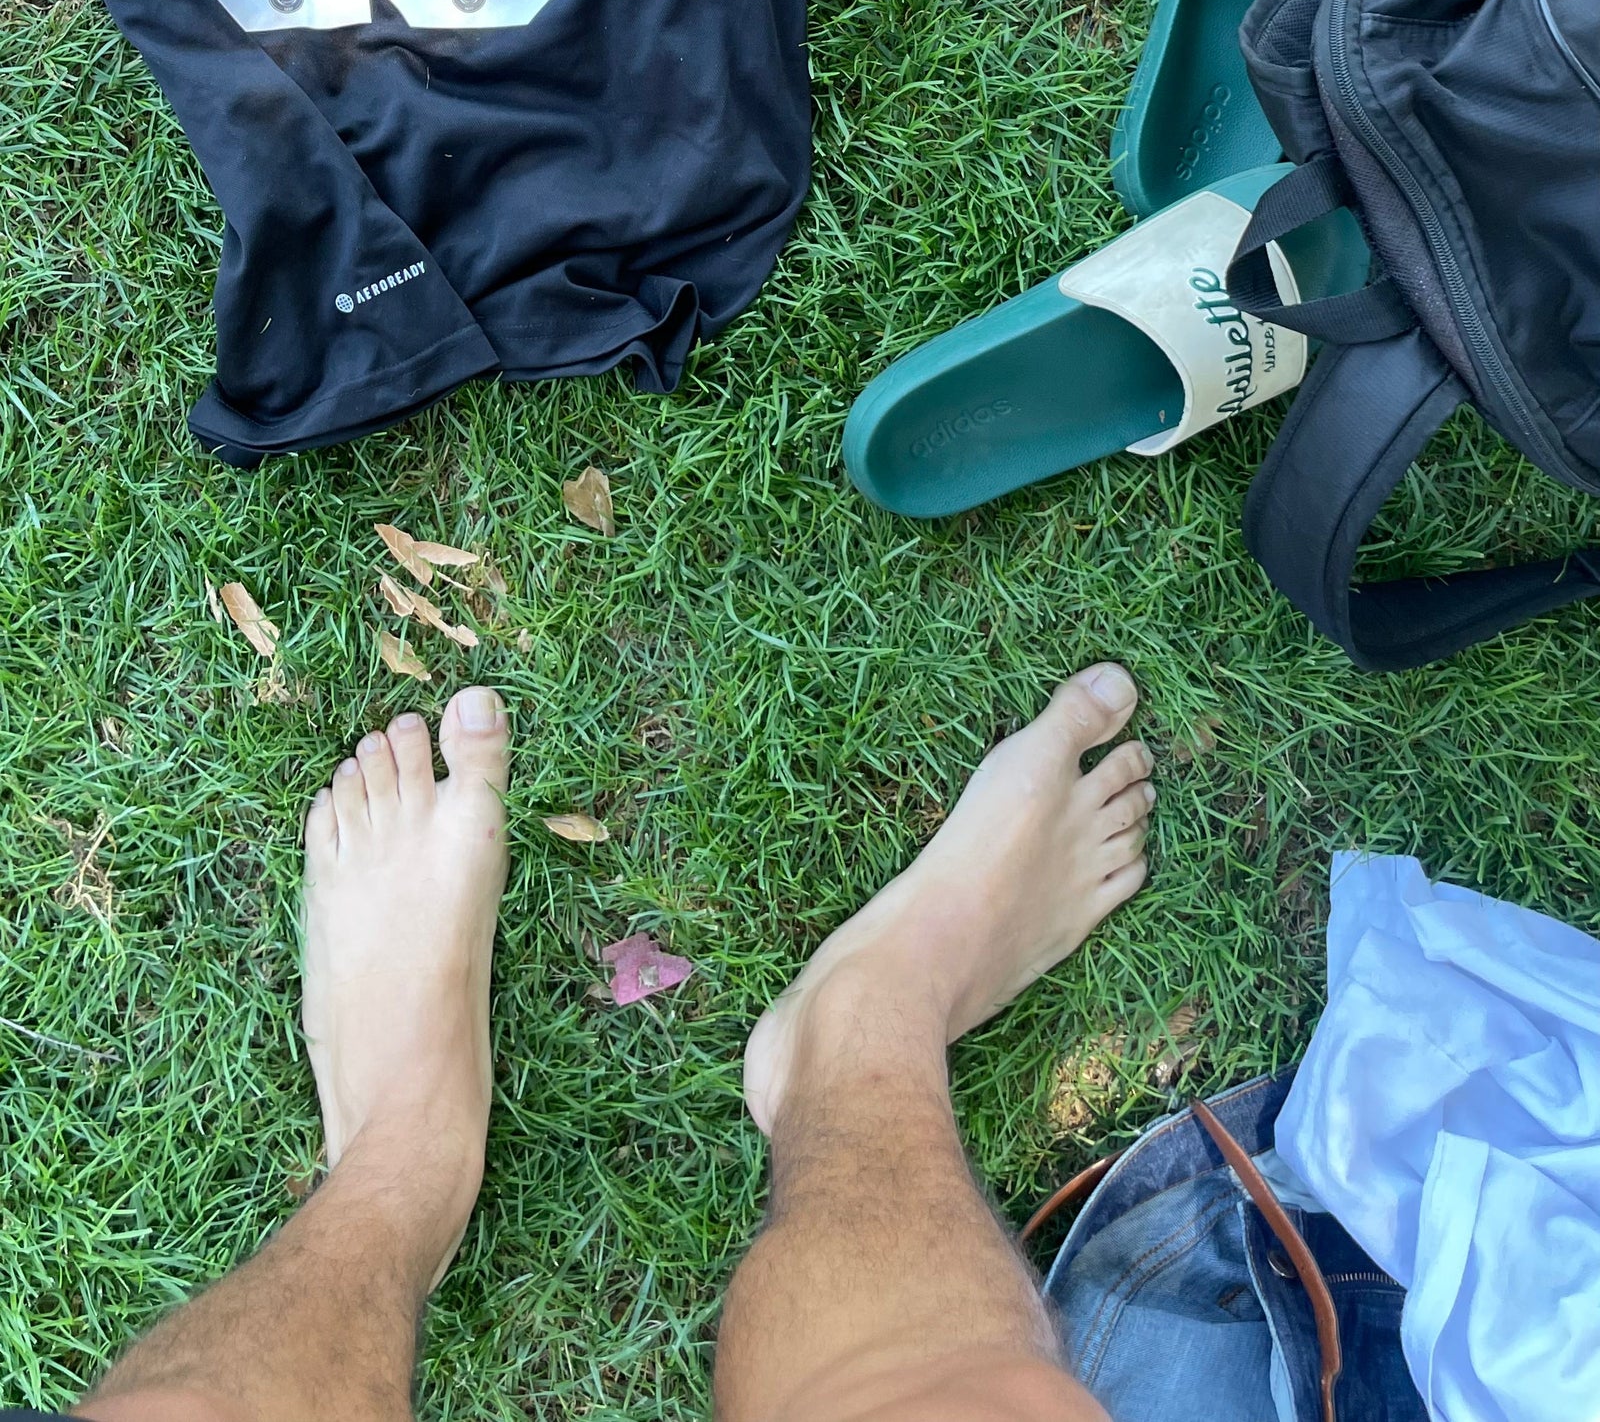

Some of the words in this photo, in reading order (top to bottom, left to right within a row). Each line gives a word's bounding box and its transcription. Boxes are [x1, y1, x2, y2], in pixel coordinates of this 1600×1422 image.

[1175, 83, 1232, 181] adidas
[355, 260, 426, 305] AEROREADY
[1188, 267, 1258, 418] Adilette
[1263, 326, 1276, 373] since
[909, 399, 1013, 459] adidas
